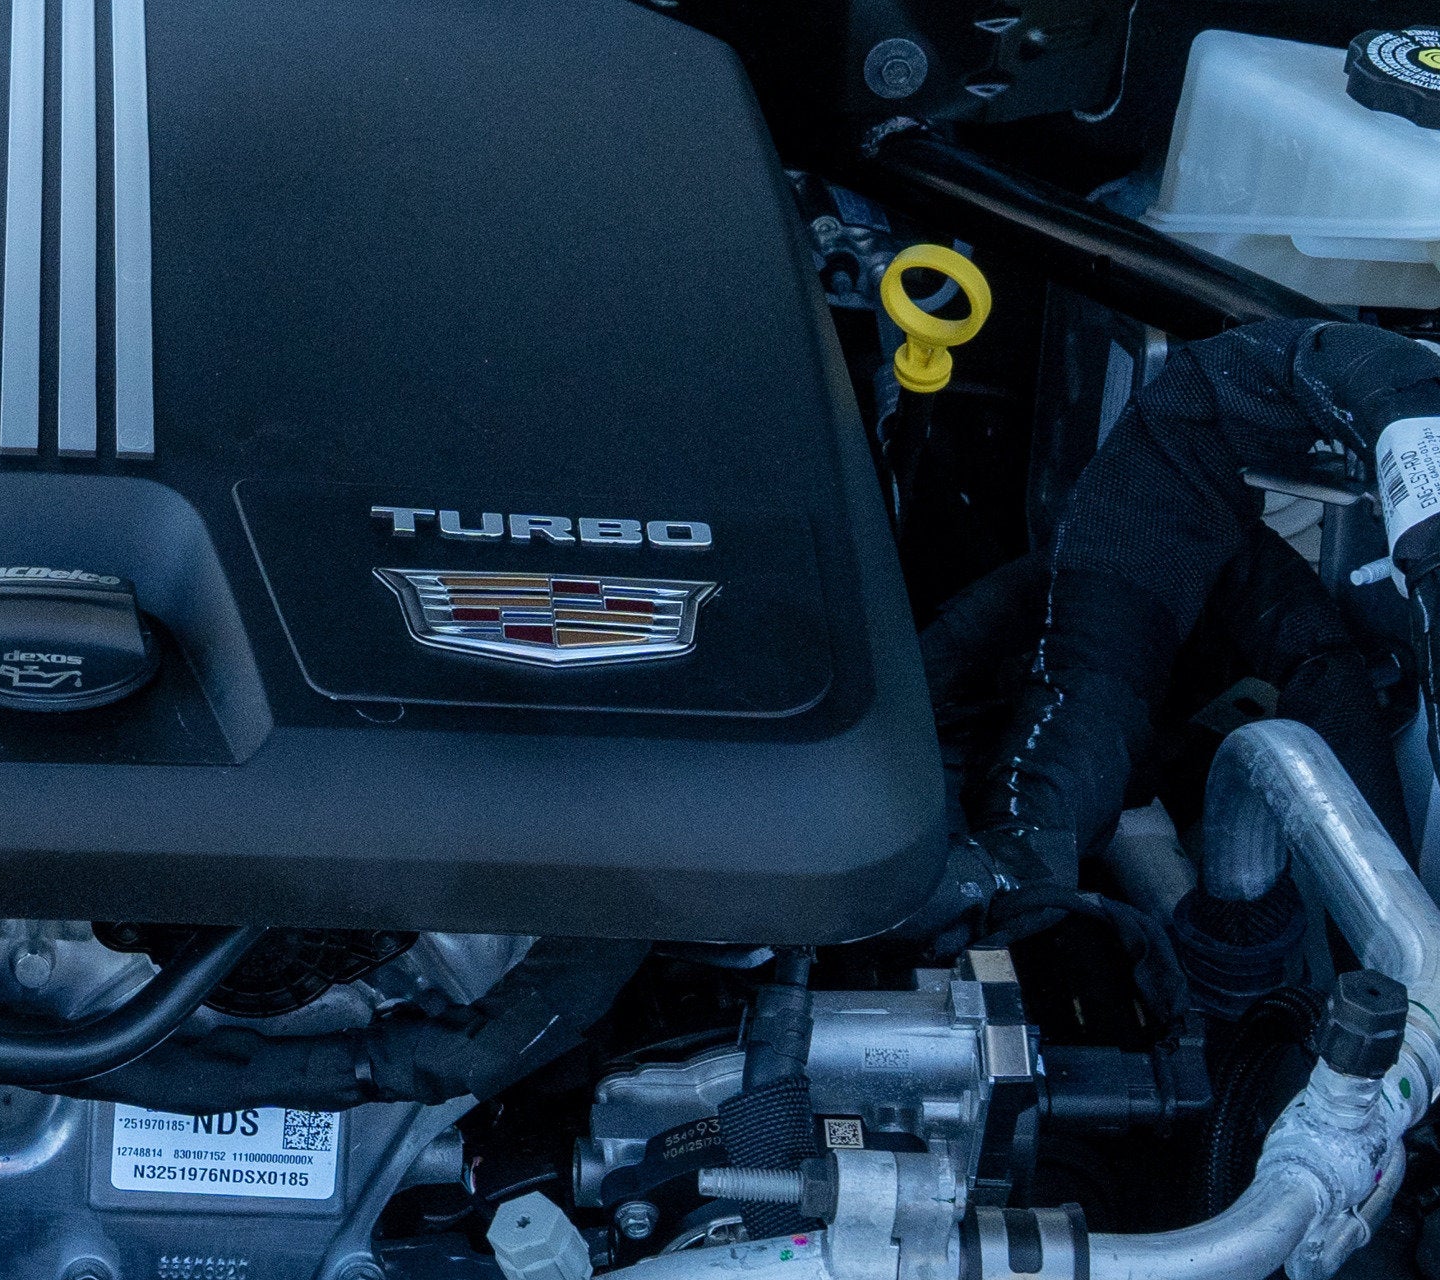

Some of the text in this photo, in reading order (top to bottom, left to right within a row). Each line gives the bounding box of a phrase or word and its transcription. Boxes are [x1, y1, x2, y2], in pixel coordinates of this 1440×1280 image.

[371, 505, 713, 551] TURBO
[3, 650, 84, 665] dexos
[193, 1108, 259, 1137] NDS
[116, 1146, 162, 1158] 12748814
[173, 1149, 226, 1162] 830107152
[133, 1164, 310, 1187] N3251976NDSX0185
